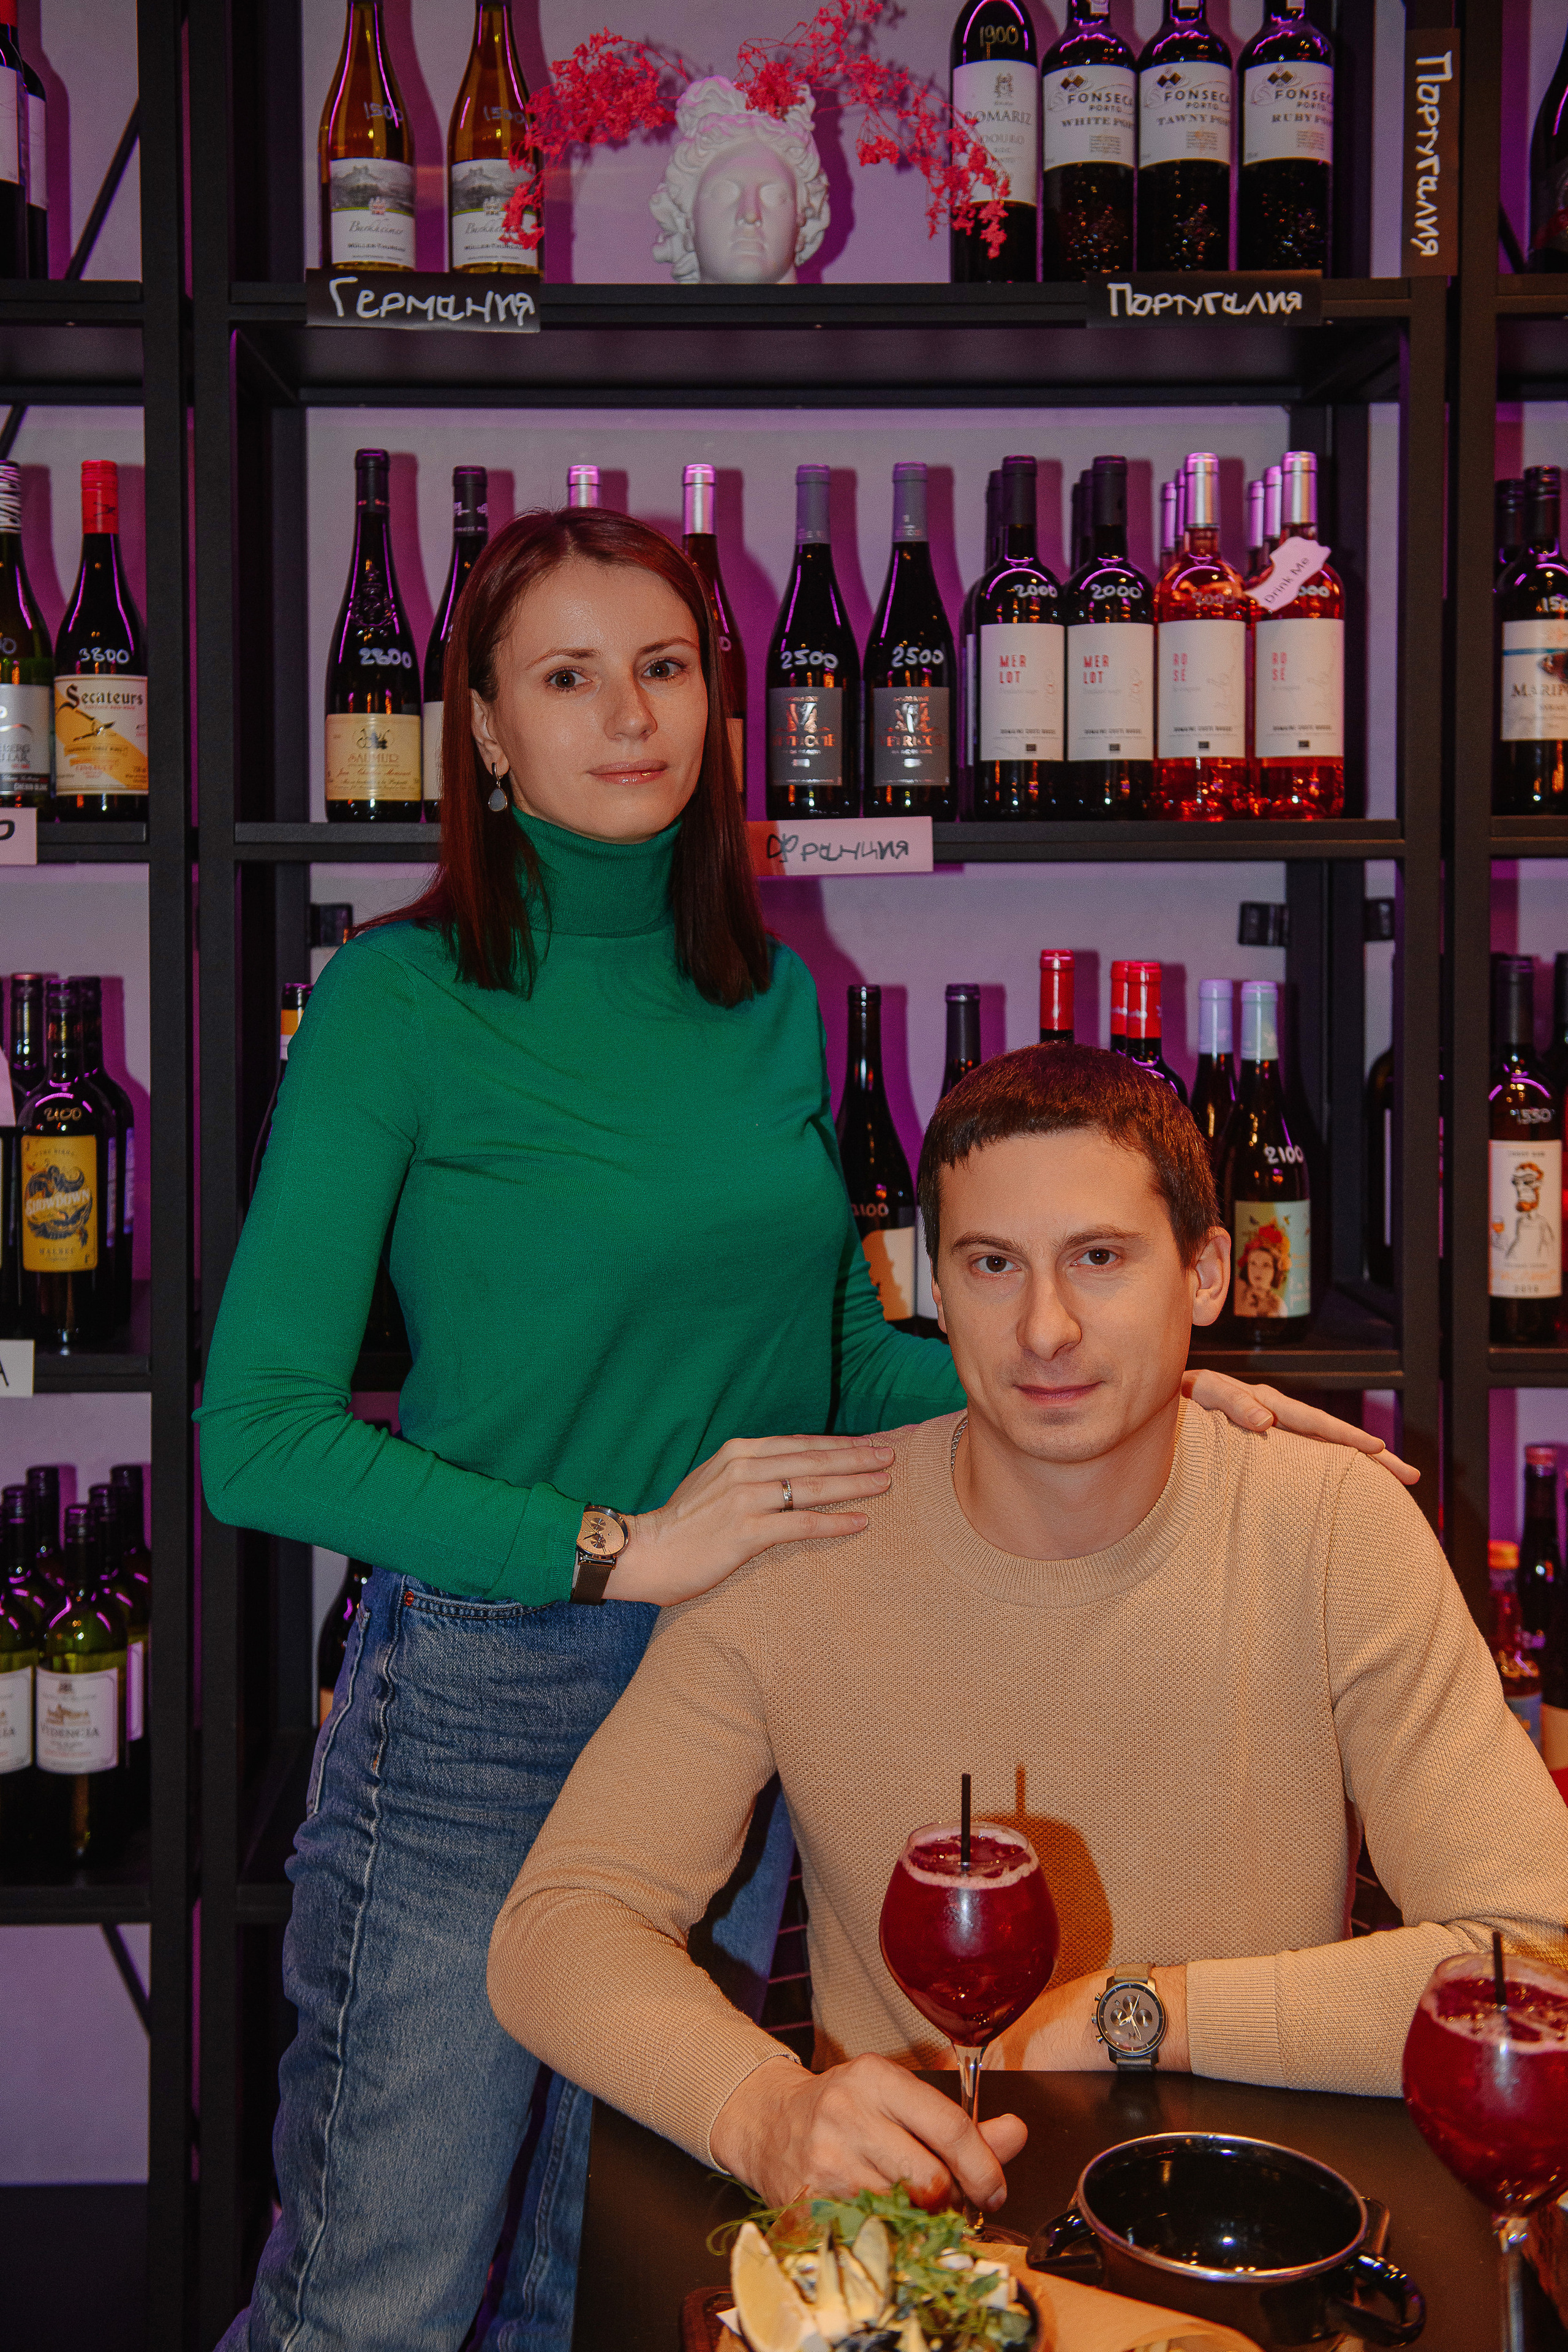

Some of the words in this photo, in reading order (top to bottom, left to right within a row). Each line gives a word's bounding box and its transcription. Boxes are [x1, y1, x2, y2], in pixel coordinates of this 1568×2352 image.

[1061, 116, 1111, 127] WHITE
[1156, 113, 1208, 126] TAWNY
[1272, 113, 1312, 123] RUBY
[1410, 50, 1453, 257] Португалия
[328, 276, 536, 326] Германия
[1106, 282, 1303, 317] Португалия
[1264, 576, 1293, 603] Drink
[1290, 557, 1310, 575] Me
[1013, 582, 1058, 599] 2000
[1089, 583, 1143, 600] 2000
[780, 648, 839, 670] 2500
[891, 646, 945, 668] 2500
[1000, 654, 1027, 668] MER
[1083, 654, 1110, 668] MER
[1000, 671, 1021, 684] LOT
[1083, 671, 1104, 684] LOT
[66, 684, 143, 709] Secateurs
[766, 833, 909, 864] Франция
[43, 1107, 82, 1121] 2100
[1264, 1145, 1304, 1164] 2100
[25, 1188, 91, 1217] SHOWDOWN
